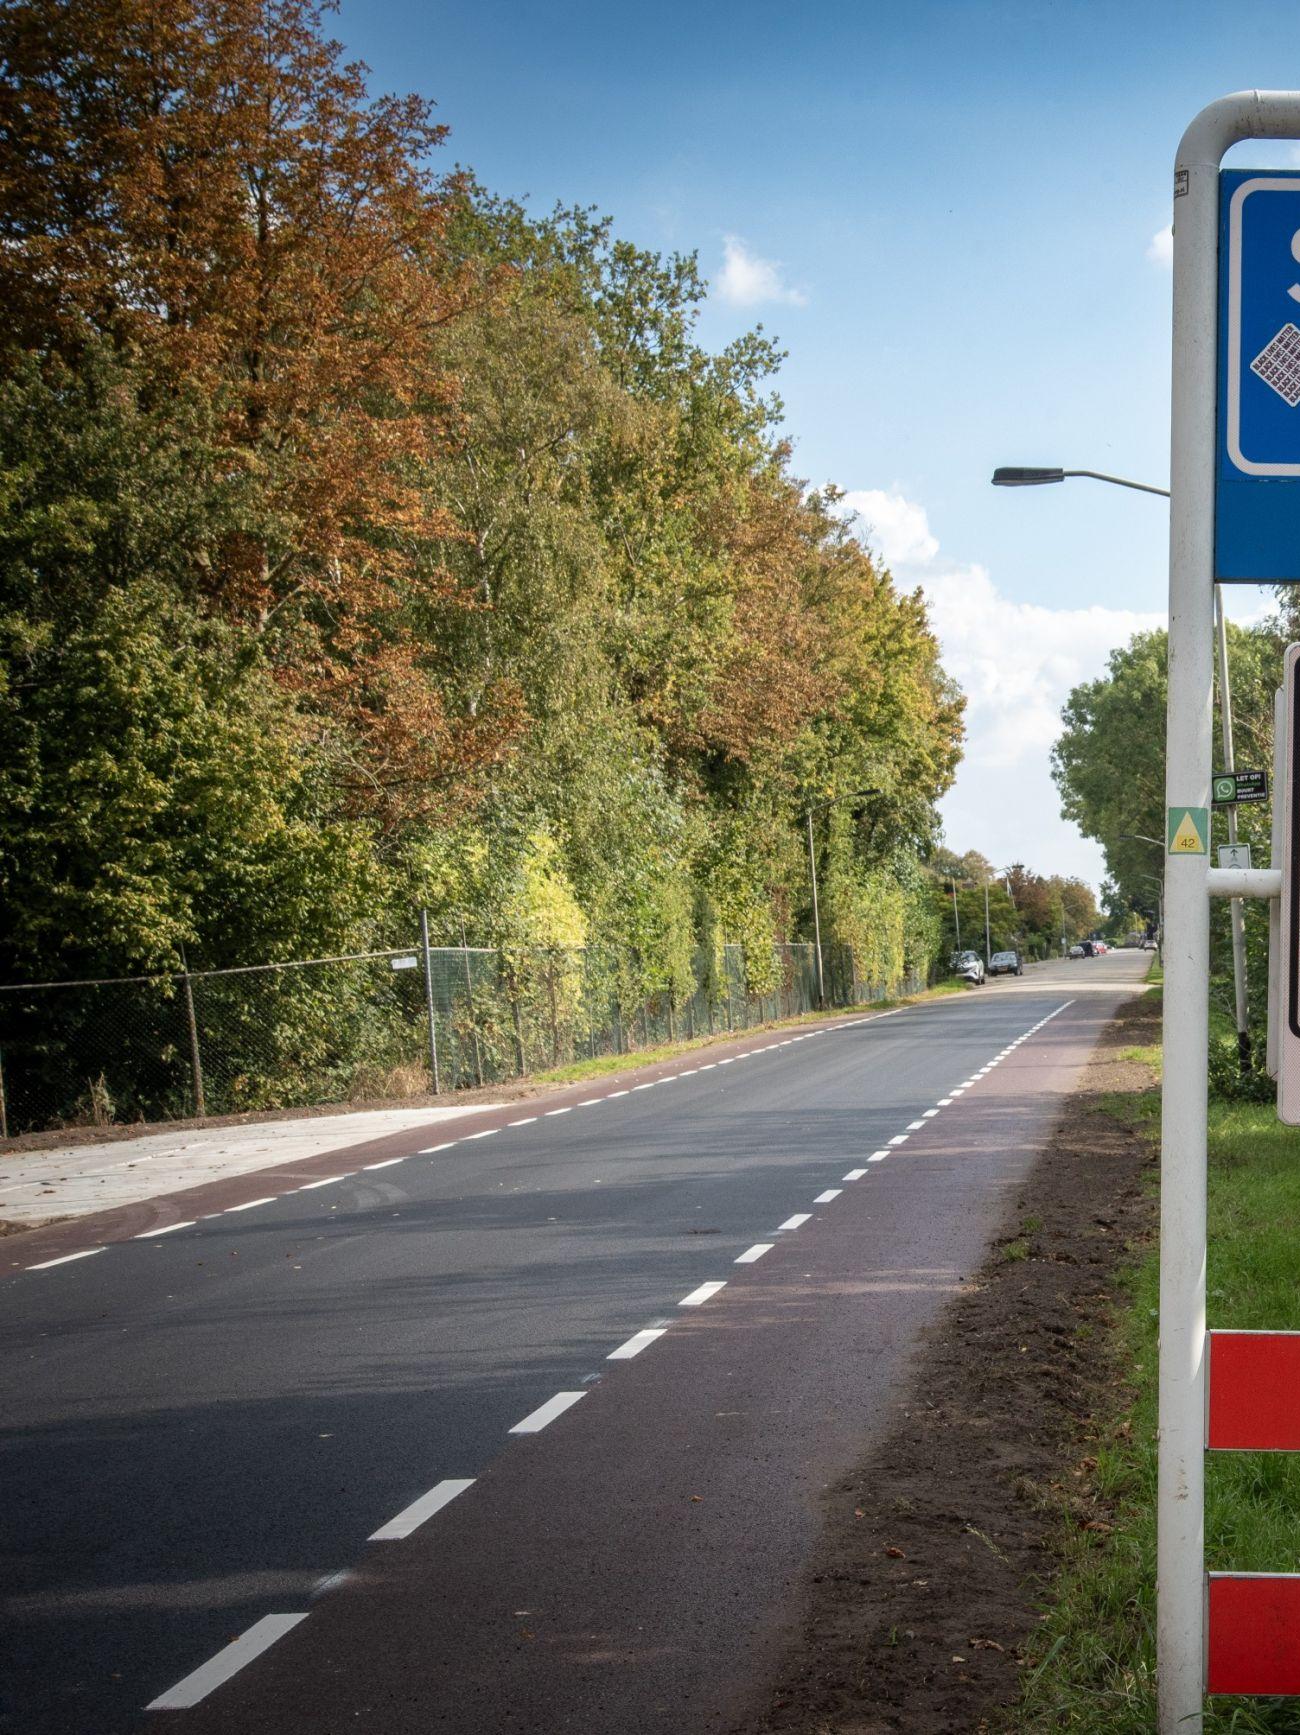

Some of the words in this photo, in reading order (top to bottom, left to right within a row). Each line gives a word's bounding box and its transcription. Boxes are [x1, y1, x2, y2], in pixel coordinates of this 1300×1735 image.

[1253, 355, 1267, 371] BLACK
[1266, 343, 1279, 356] LIVES
[1276, 326, 1294, 344] MATTER
[1259, 360, 1273, 376] BLACK
[1272, 348, 1285, 362] LIVES
[1282, 331, 1300, 349] MATTER
[1265, 366, 1280, 382] BLACK
[1278, 354, 1291, 367] LIVES
[1271, 371, 1286, 387] BLACK
[1284, 359, 1297, 372] LIVES
[1277, 377, 1292, 393] BLACK
[1283, 382, 1298, 398] BLACK
[1181, 838, 1195, 848] 42
